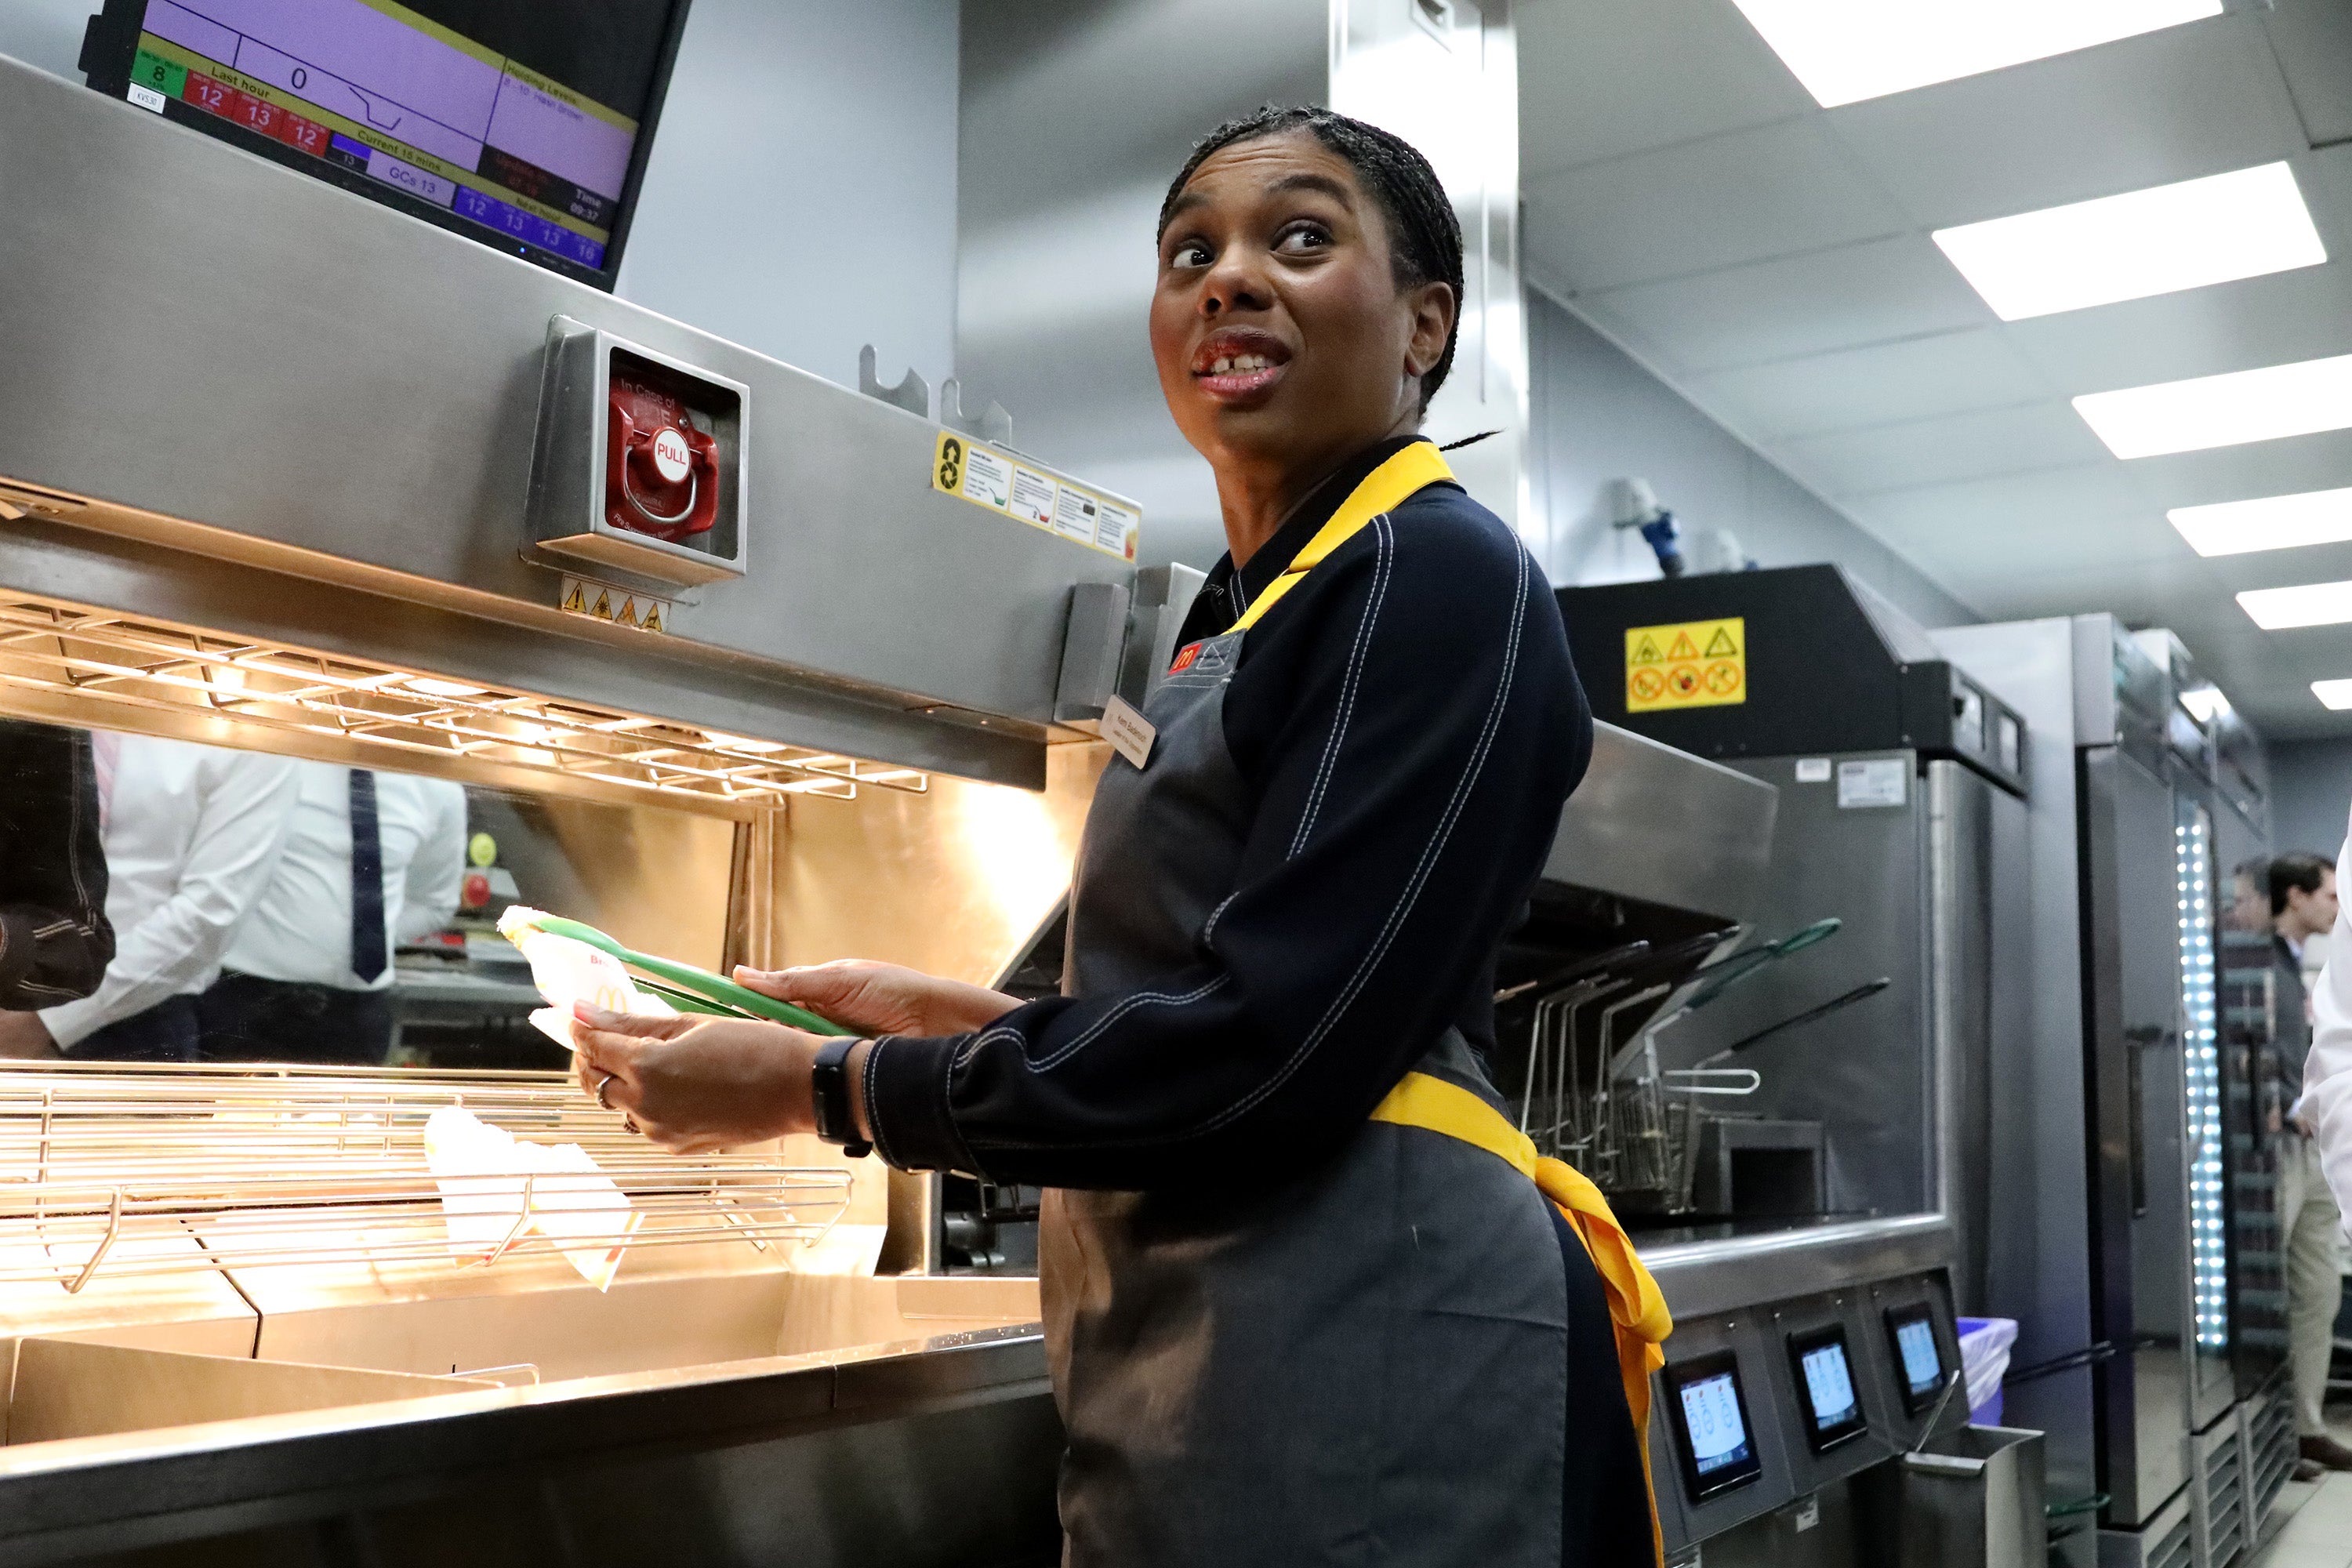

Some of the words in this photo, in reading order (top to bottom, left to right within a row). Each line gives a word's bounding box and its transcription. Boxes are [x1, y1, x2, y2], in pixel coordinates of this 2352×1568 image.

[153, 66, 165, 82] 8
[212, 67, 238, 86] Last
[241, 79, 270, 99] hour
[292, 67, 307, 89] 0
[201, 85, 223, 107] 12
[249, 106, 270, 126] 13
[296, 125, 317, 146] 12
[358, 130, 398, 154] Current
[344, 154, 355, 165] 13
[389, 167, 416, 187] GCs
[422, 180, 436, 194] 13
[468, 198, 487, 216] 12
[576, 188, 602, 209] Time
[507, 214, 524, 231] 13
[544, 229, 561, 246] 13
[621, 378, 633, 394] In
[636, 384, 663, 405] Case
[665, 398, 675, 411] of
[657, 443, 686, 465] PULL
